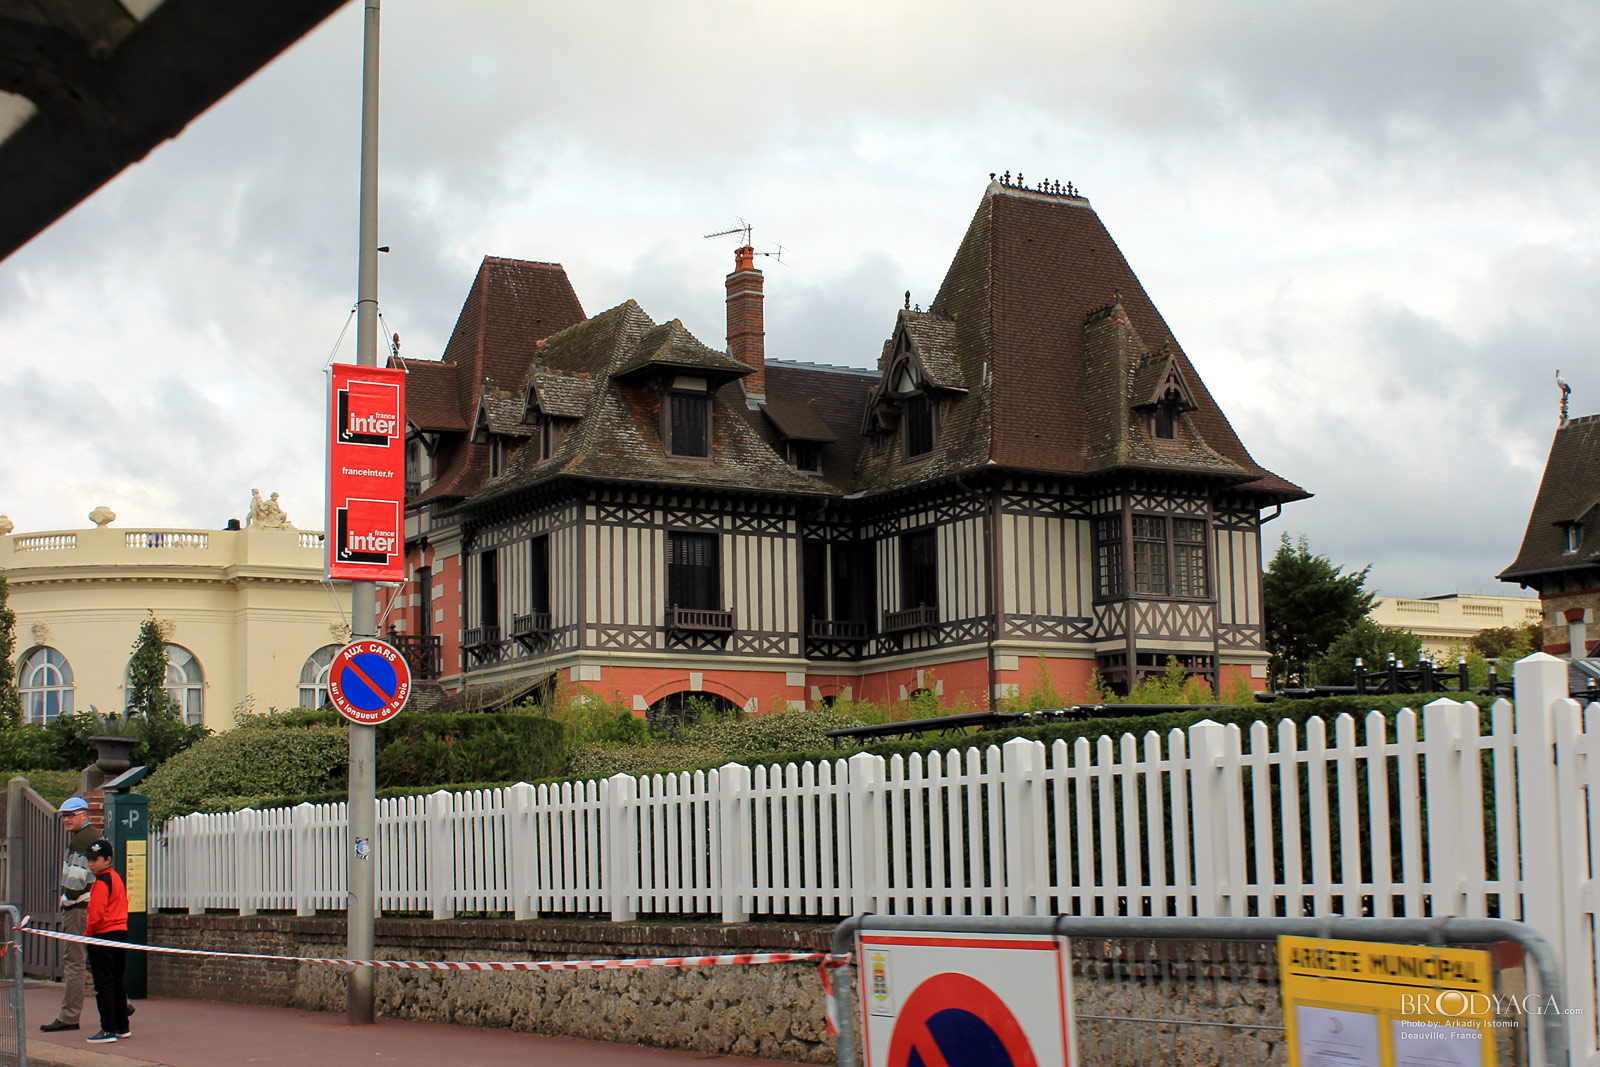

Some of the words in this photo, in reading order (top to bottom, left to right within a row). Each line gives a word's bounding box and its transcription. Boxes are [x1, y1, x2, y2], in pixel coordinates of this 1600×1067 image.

[350, 412, 396, 434] inter
[375, 412, 396, 420] france
[342, 466, 394, 478] franceinter.fr
[349, 530, 395, 552] inter
[374, 529, 395, 537] france
[343, 644, 364, 660] AUX
[369, 643, 397, 662] CARS
[331, 682, 339, 695] sur
[336, 696, 345, 706] la
[344, 703, 379, 719] longueur
[381, 708, 392, 717] de
[390, 700, 400, 709] la
[398, 682, 408, 699] voie
[129, 809, 140, 829] P
